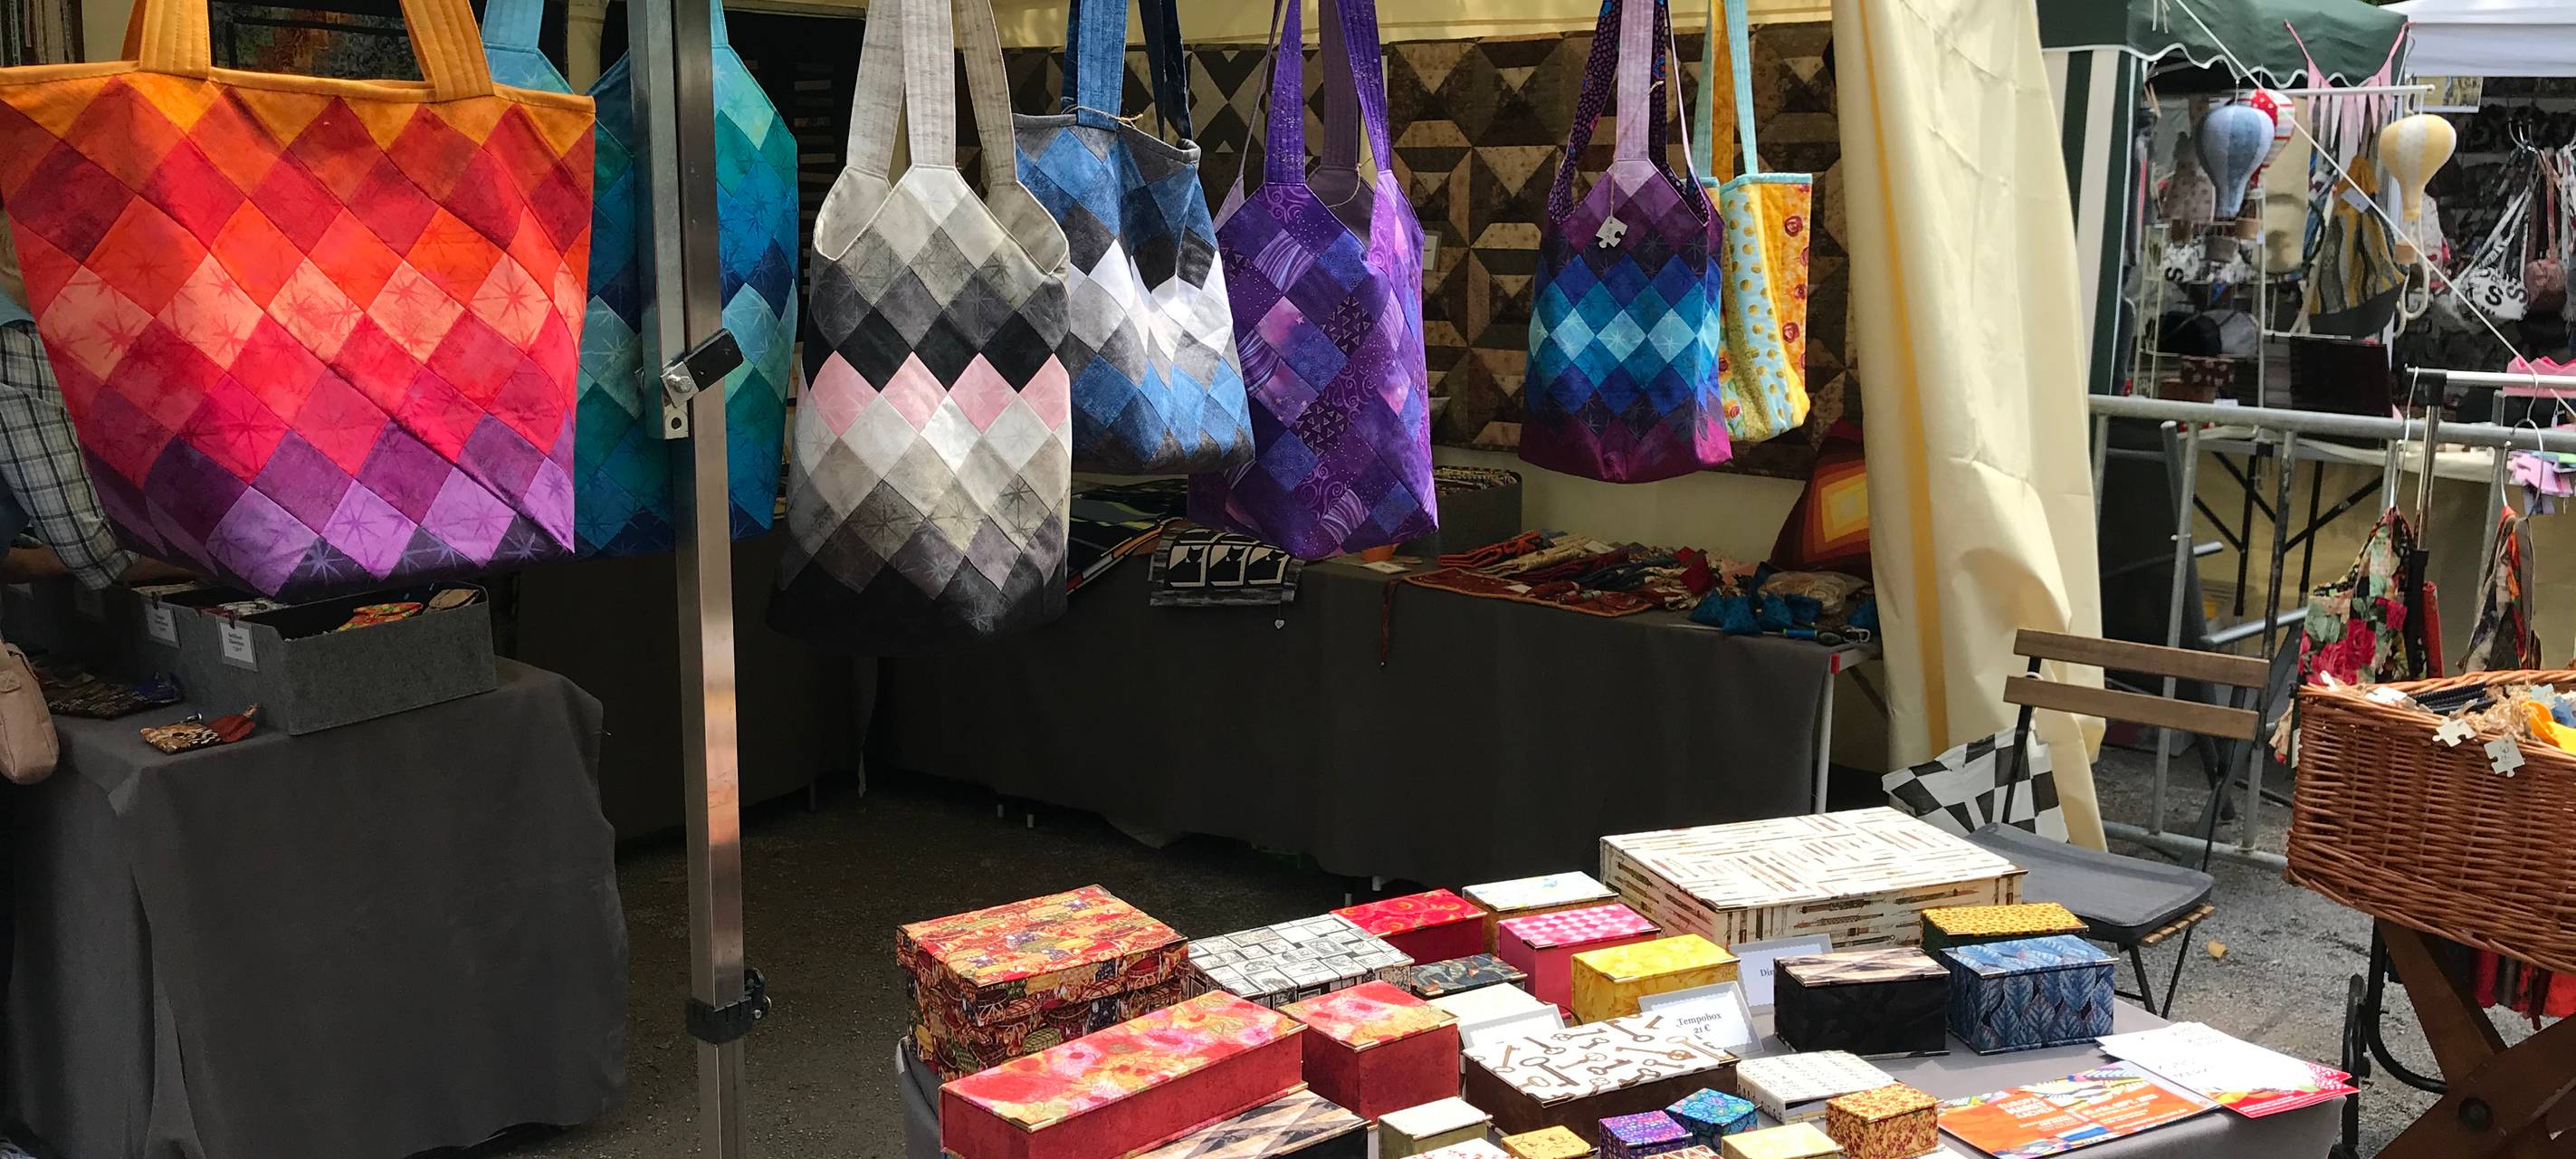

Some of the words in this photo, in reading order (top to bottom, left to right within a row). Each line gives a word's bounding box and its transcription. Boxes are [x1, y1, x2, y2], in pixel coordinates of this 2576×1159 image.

[2485, 285, 2504, 306] S
[1676, 1012, 1722, 1027] Tempobox
[1704, 1024, 1711, 1032] €
